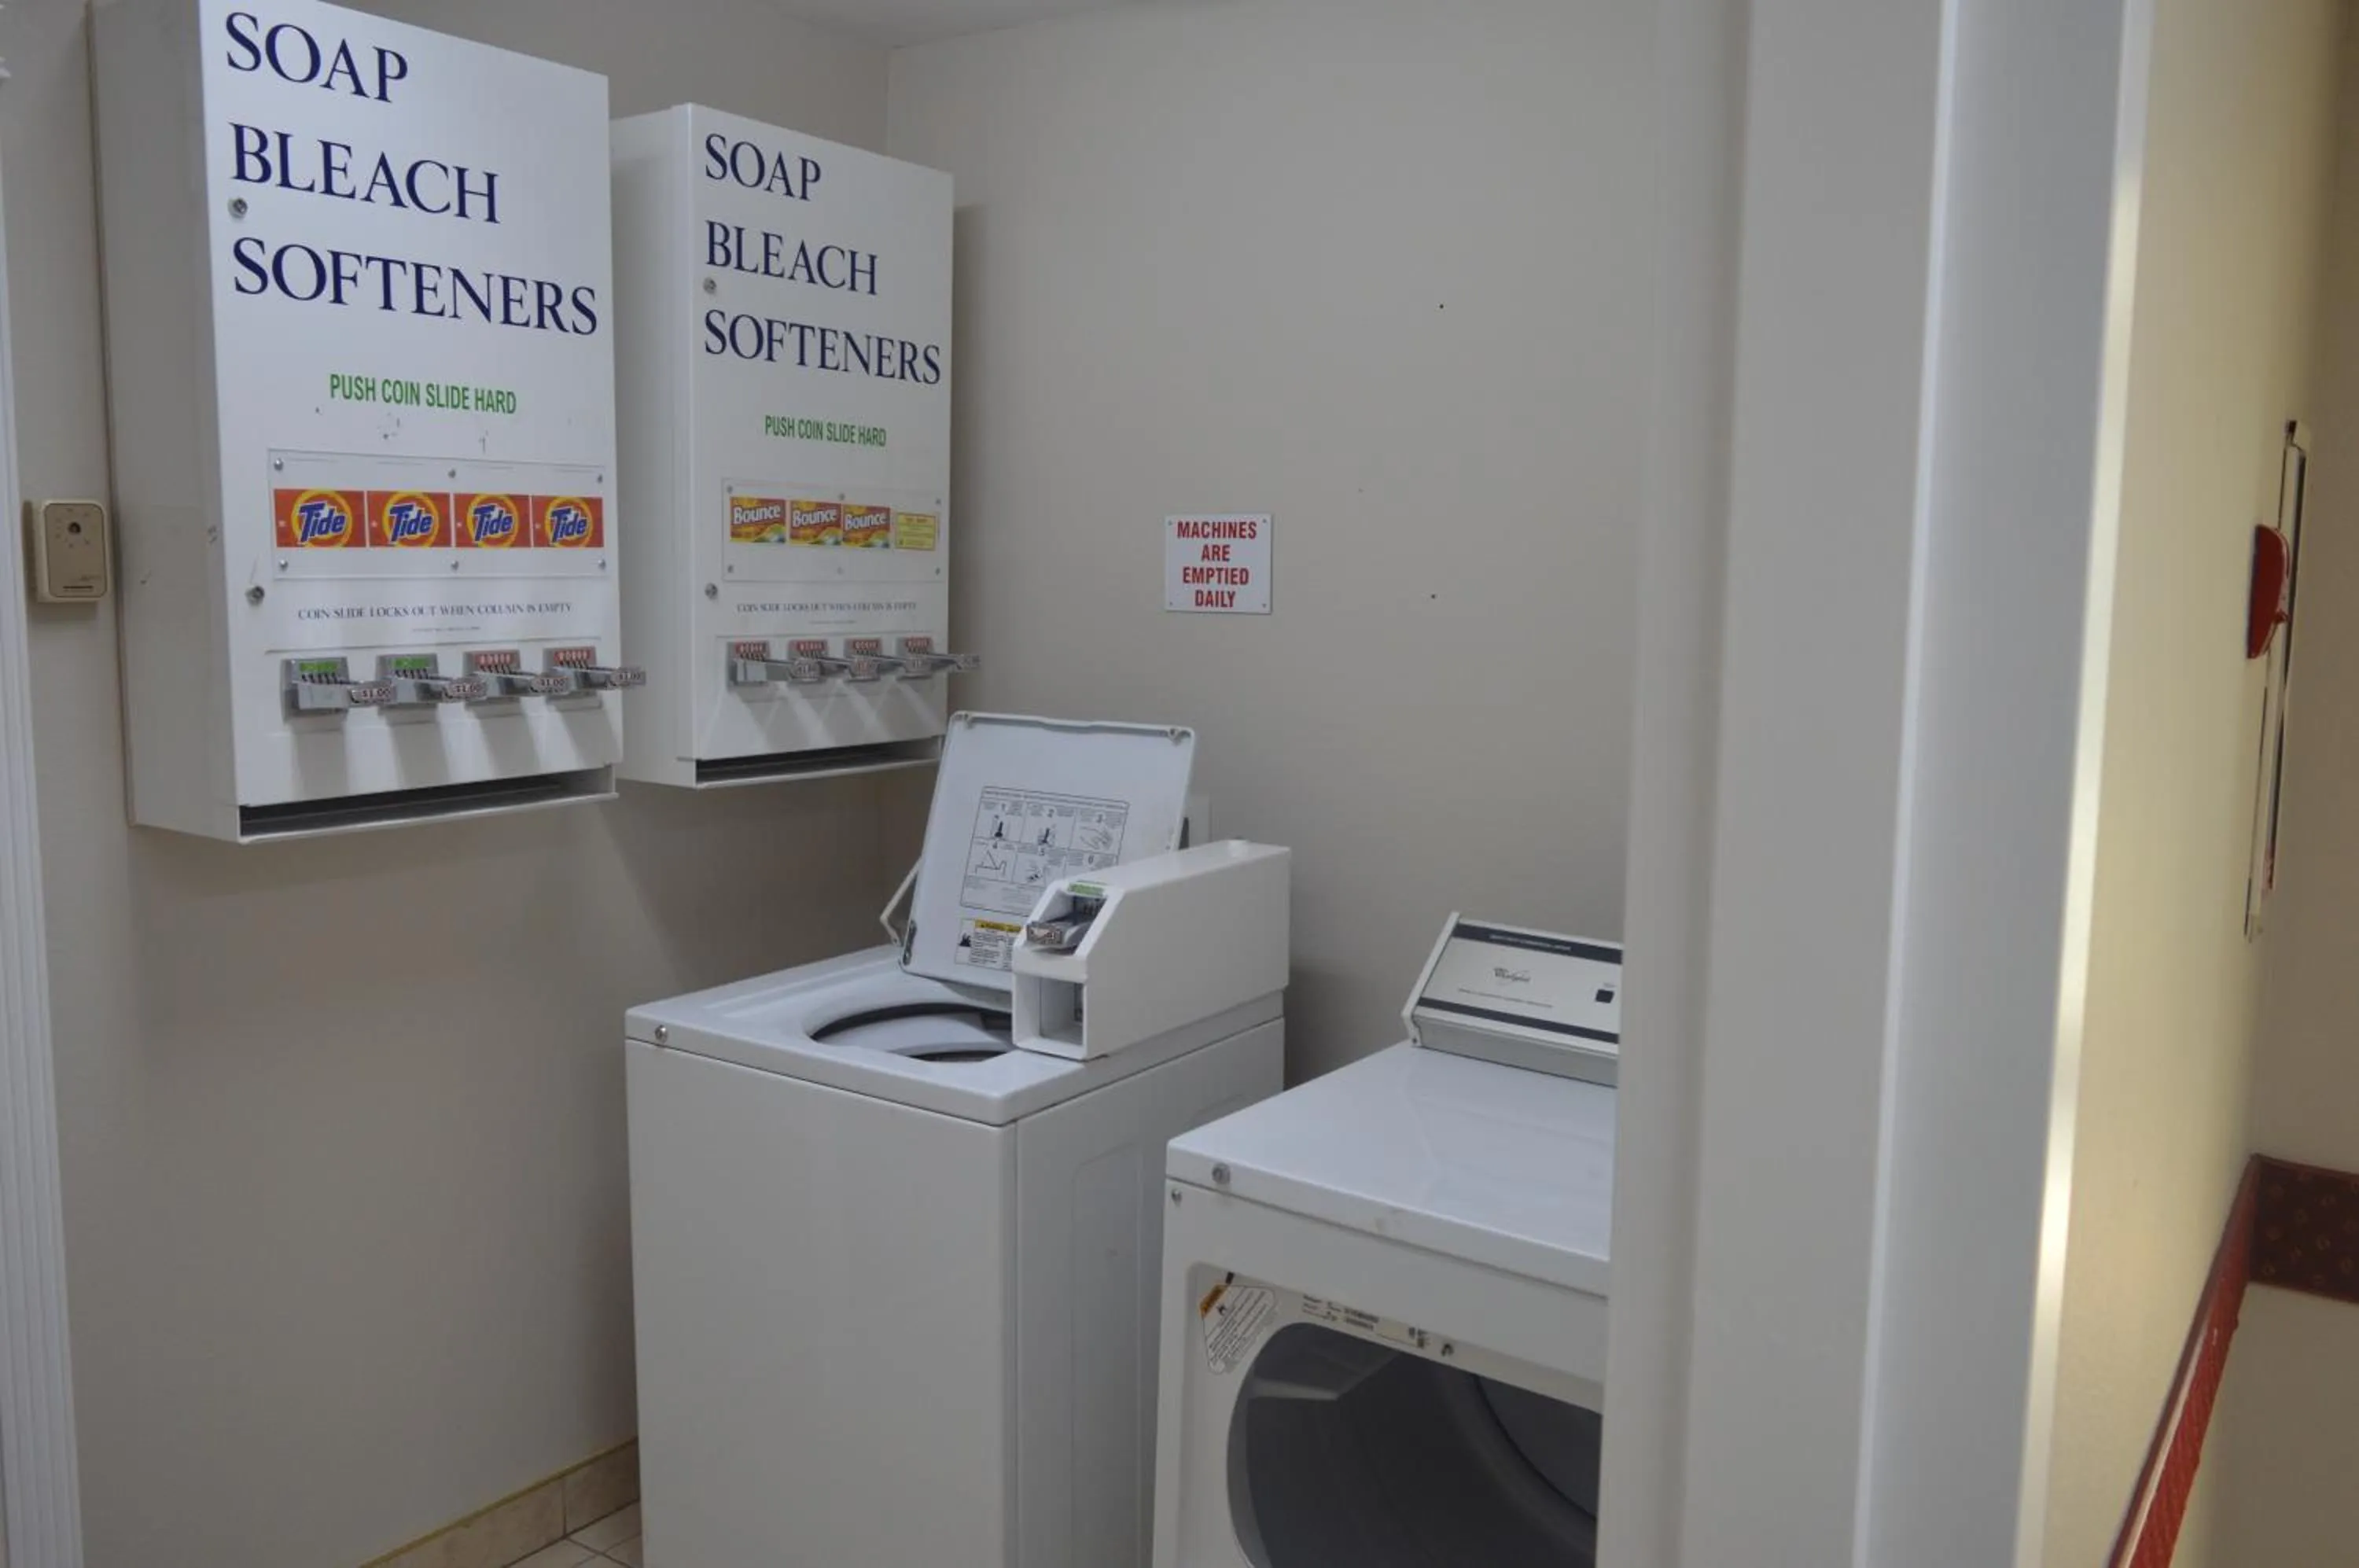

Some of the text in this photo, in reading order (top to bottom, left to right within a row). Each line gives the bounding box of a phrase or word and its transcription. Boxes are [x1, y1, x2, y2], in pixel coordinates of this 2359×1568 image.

[226, 12, 408, 103] SOAP
[229, 122, 500, 224] BLEACH
[705, 133, 821, 201] SOAP
[705, 219, 878, 296] BLEACH
[233, 237, 598, 336] SOFTENERS
[705, 309, 940, 385] SOFTENERS
[329, 374, 517, 414] PUSH COIN SLIDE HARD
[764, 414, 887, 447] PUSH COIN SLIDE HARD
[300, 502, 345, 543] Tide
[390, 503, 432, 543] Tide
[473, 504, 513, 541] Tide
[550, 507, 587, 543] Tide
[733, 505, 781, 525] Bounce
[792, 508, 837, 527] Bounce
[845, 513, 887, 531] Bounce
[1177, 520, 1257, 539] MACHINES
[1201, 544, 1231, 561] ARE
[1182, 566, 1249, 585] EMPTIED
[1194, 590, 1236, 608] DAILY
